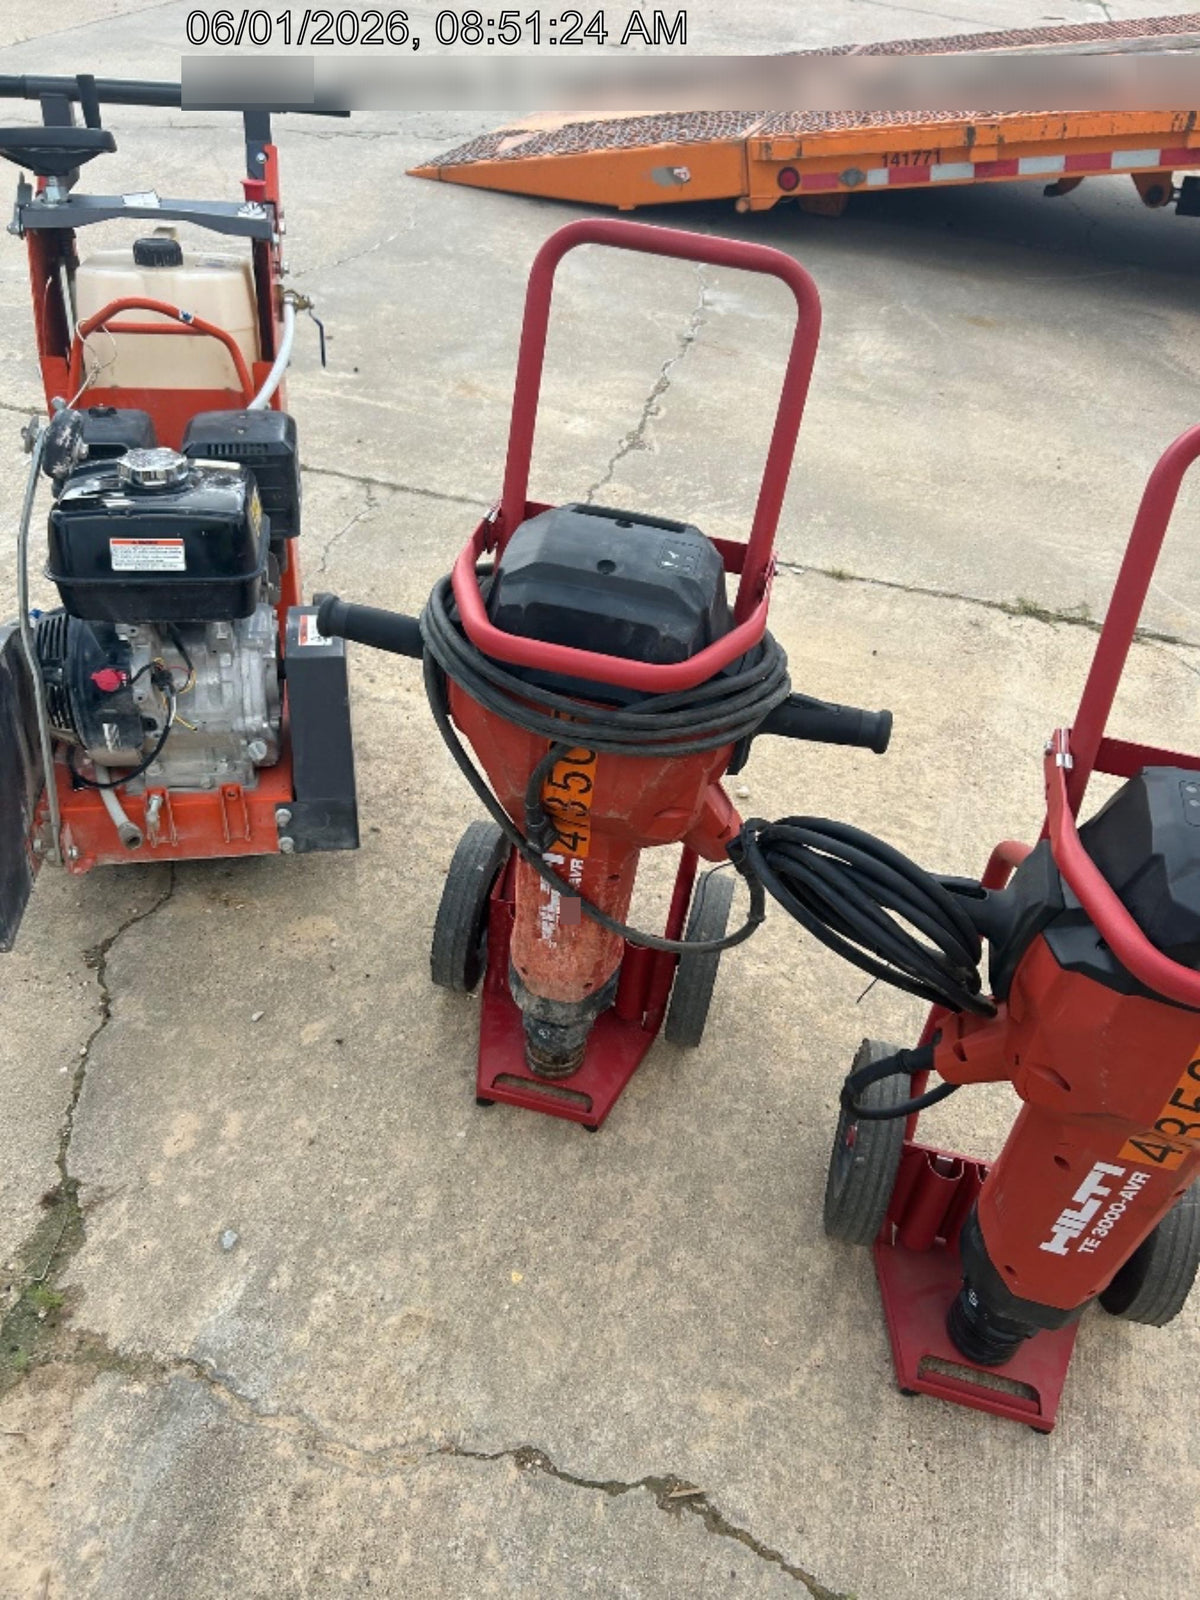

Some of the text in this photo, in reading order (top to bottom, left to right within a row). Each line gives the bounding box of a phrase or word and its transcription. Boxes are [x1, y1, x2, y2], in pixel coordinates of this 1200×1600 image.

[881, 147, 941, 168] 141771
[1039, 1161, 1127, 1256] HILTI
[1077, 1170, 1152, 1254] TE 3000-AVR
